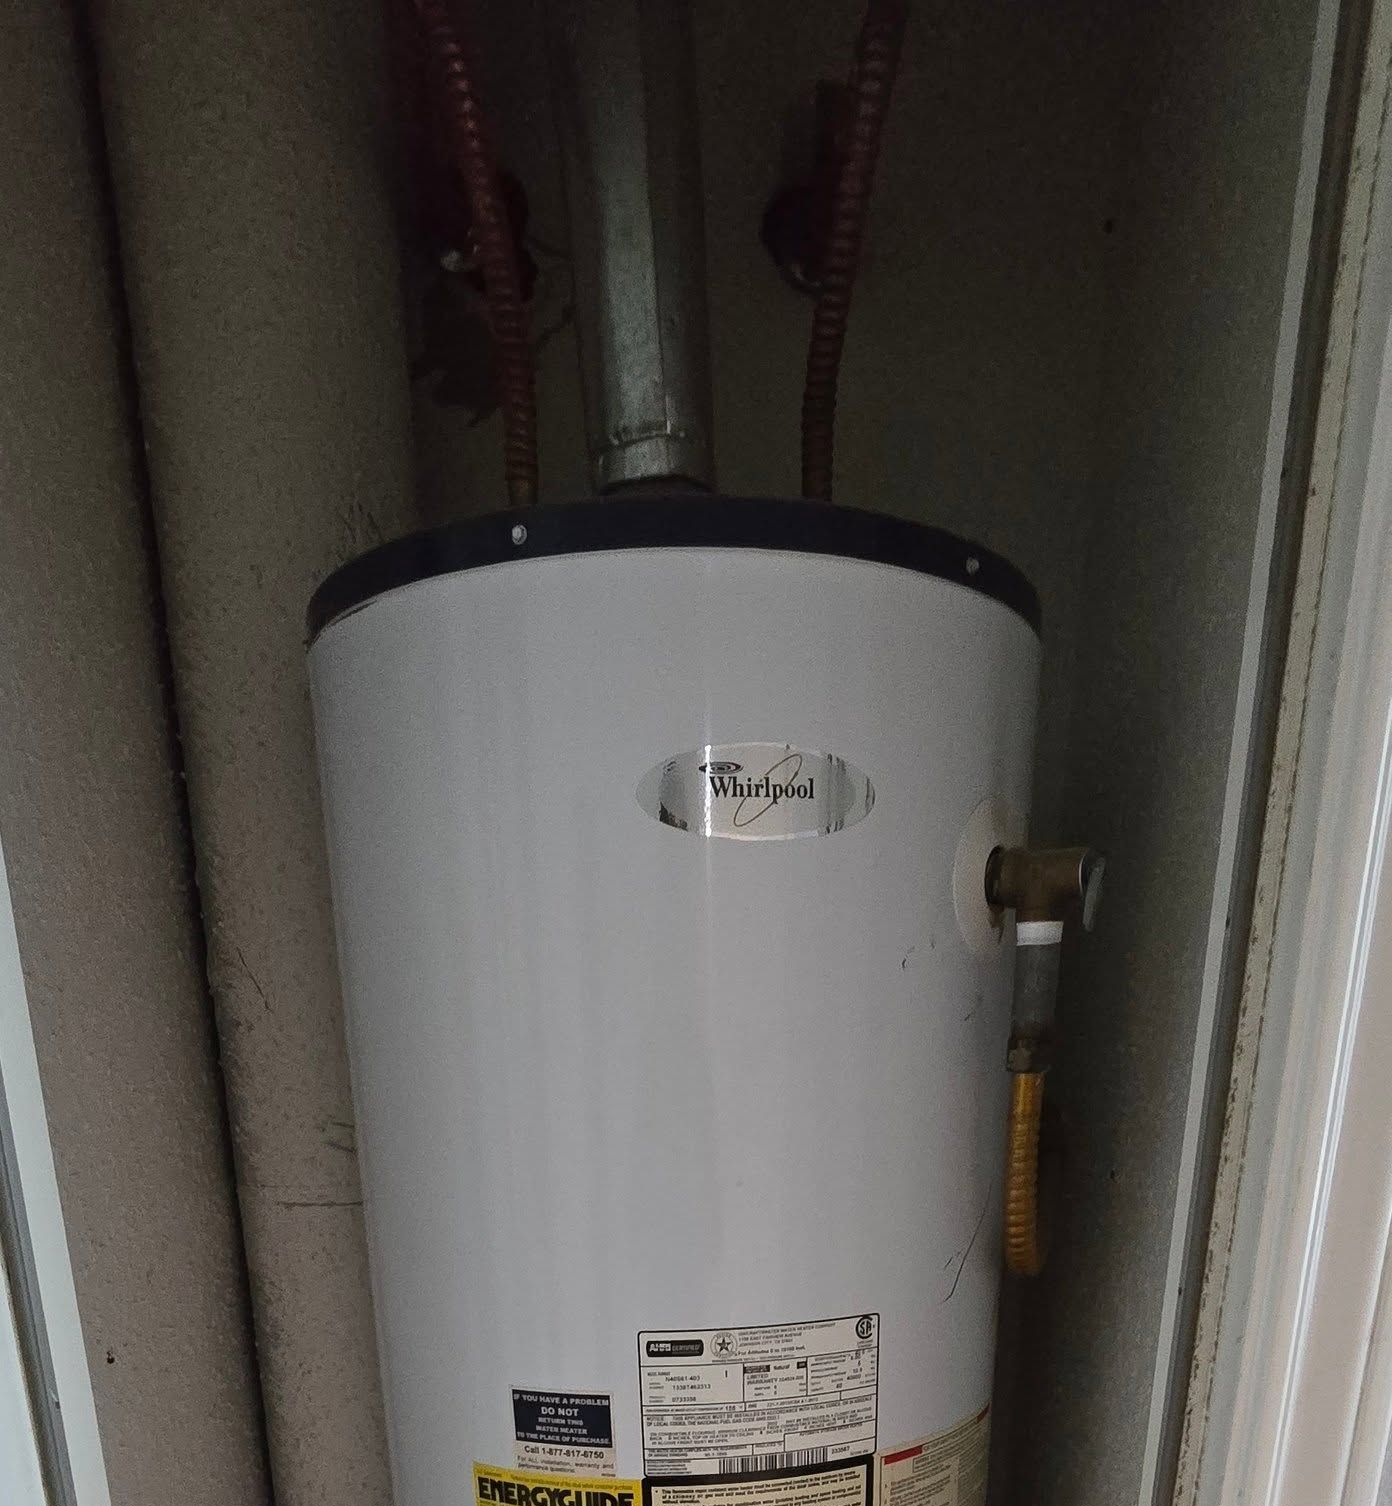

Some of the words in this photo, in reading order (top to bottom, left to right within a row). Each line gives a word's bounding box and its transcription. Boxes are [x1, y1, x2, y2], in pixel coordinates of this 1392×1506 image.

[709, 776, 814, 804] Whirlpool
[540, 1396, 560, 1404] HAVE
[558, 1408, 579, 1416] NOT
[524, 1446, 539, 1454] Call
